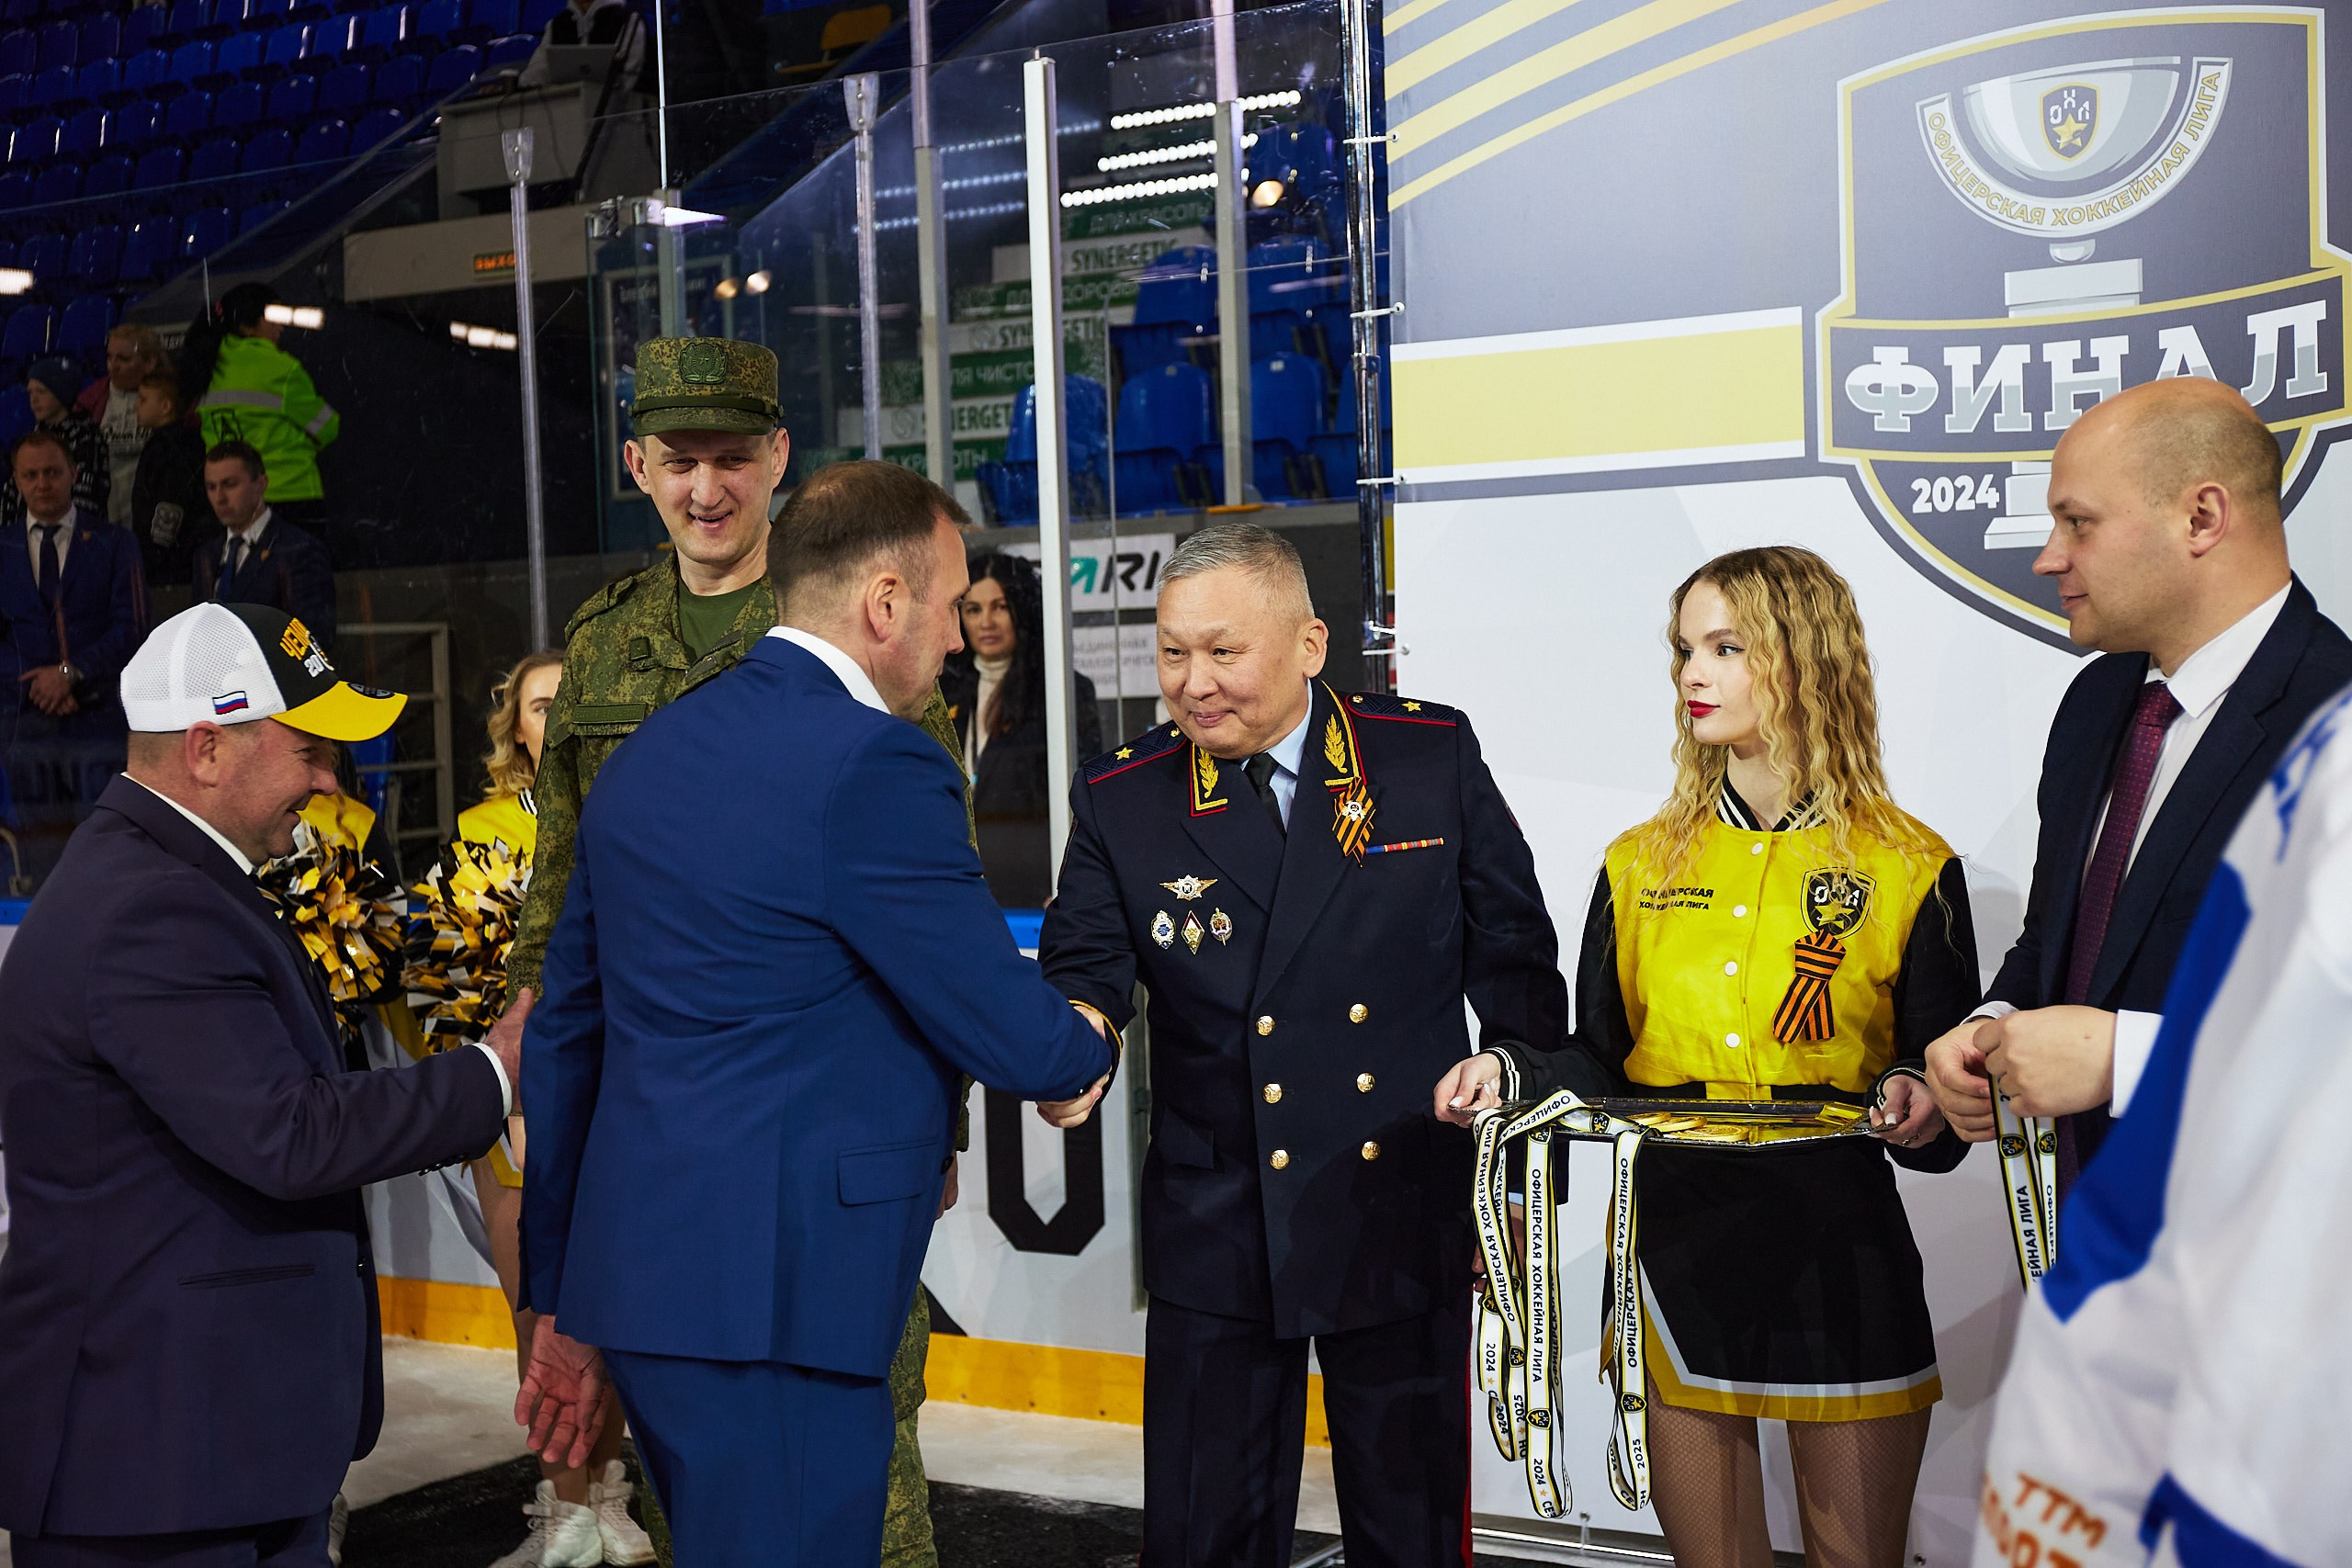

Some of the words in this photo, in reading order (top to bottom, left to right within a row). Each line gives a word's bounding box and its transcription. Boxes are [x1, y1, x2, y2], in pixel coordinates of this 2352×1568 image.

[1928, 112, 2045, 225] ОФИЦЕРСКАЯ
[2051, 141, 2190, 227] ХОККЕЙНАЯ
[2184, 72, 2221, 141] ЛИГА
[1845, 299, 2328, 434] ФИНАЛ
[1911, 474, 2000, 513] 2024
[1685, 901, 1710, 910] ЛИГА
[1476, 1152, 1493, 1230] ХОККЕЙНАЯ
[1531, 1168, 1544, 1259] ОФИЦЕРСКАЯ
[1616, 1157, 1629, 1249] ОФИЦЕРСКАЯ
[2016, 1185, 2033, 1224] ЛИГА
[1485, 1235, 1516, 1322] ОФИЦЕРСКАЯ
[2023, 1228, 2043, 1283] ЕЙНАЯ
[1532, 1264, 1545, 1344] ХОККЕЙНАЯ
[1486, 1343, 1497, 1371] 2024
[1532, 1348, 1543, 1383] ЛИГА
[1496, 1405, 1509, 1435] 2024
[1533, 1458, 1546, 1485] 2024
[1633, 1438, 1645, 1469] 2025
